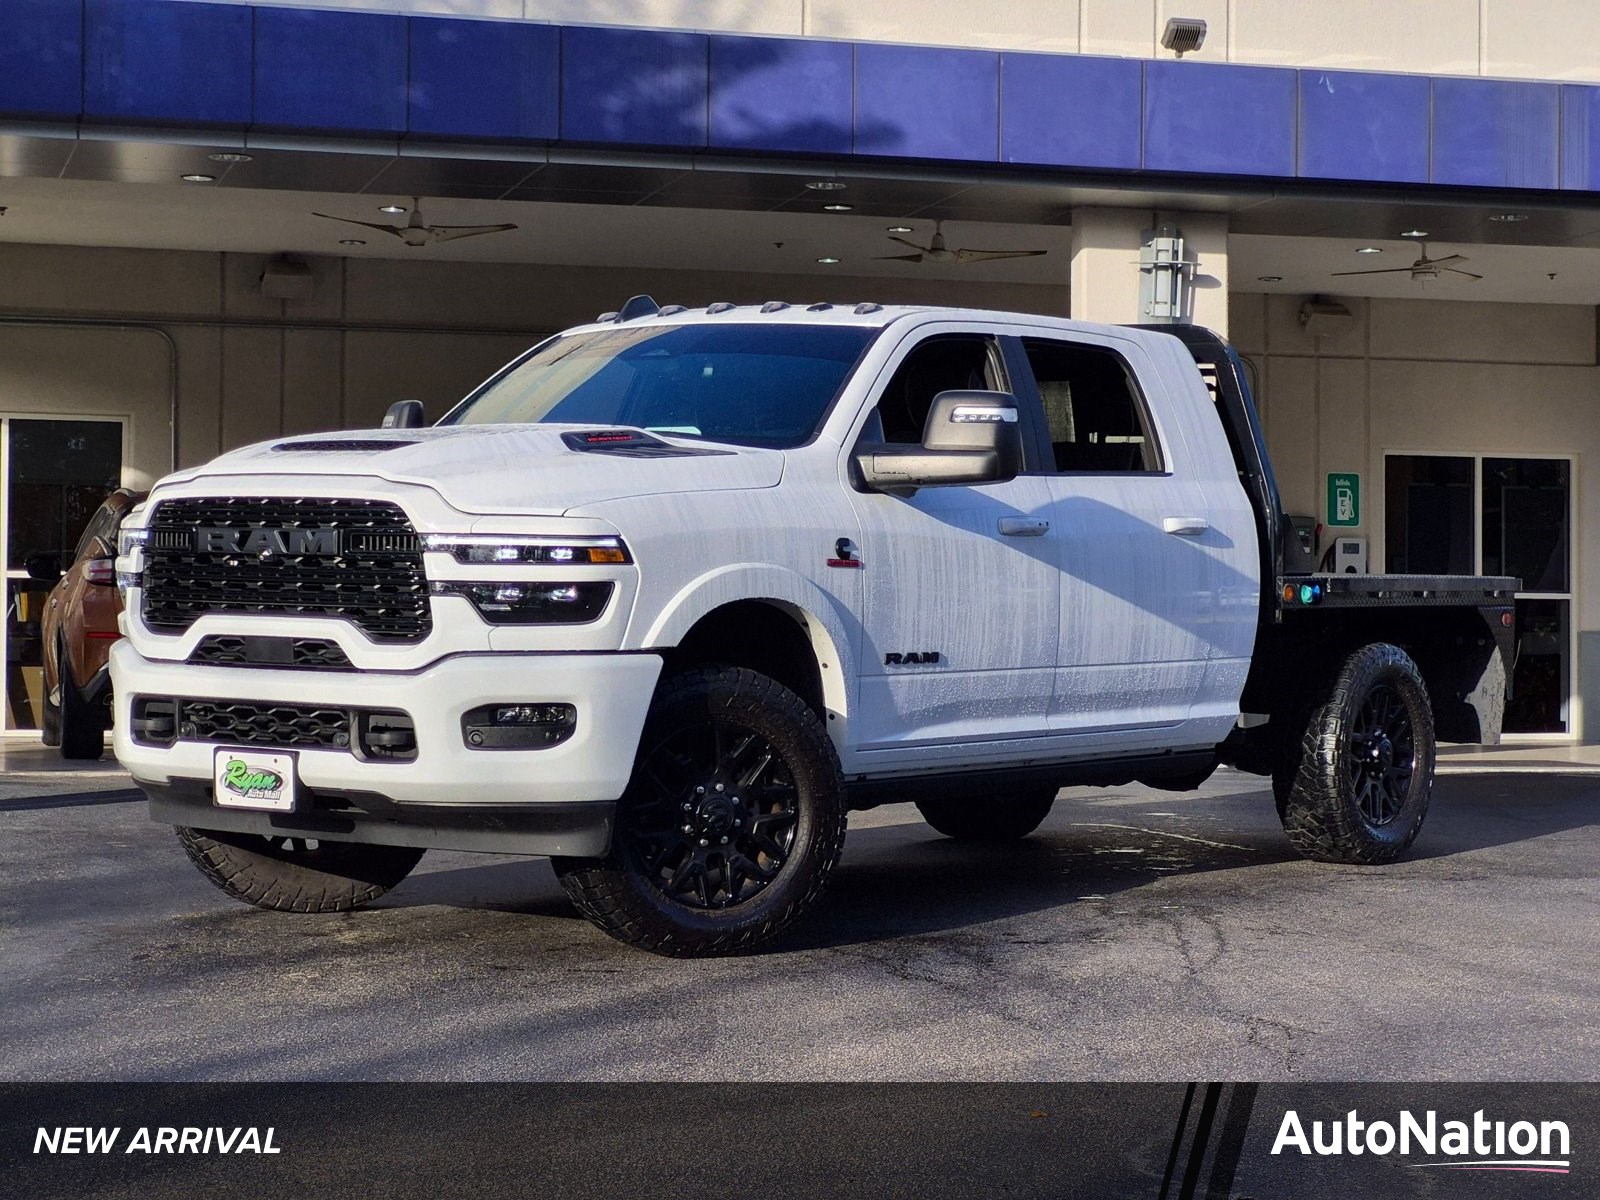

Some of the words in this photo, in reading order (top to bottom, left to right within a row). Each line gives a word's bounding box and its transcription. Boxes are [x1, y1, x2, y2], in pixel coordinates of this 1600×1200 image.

[198, 527, 338, 555] RAM
[884, 651, 940, 665] RAM
[224, 760, 276, 797] Ryan
[247, 788, 264, 799] Auto
[264, 789, 281, 800] Mall
